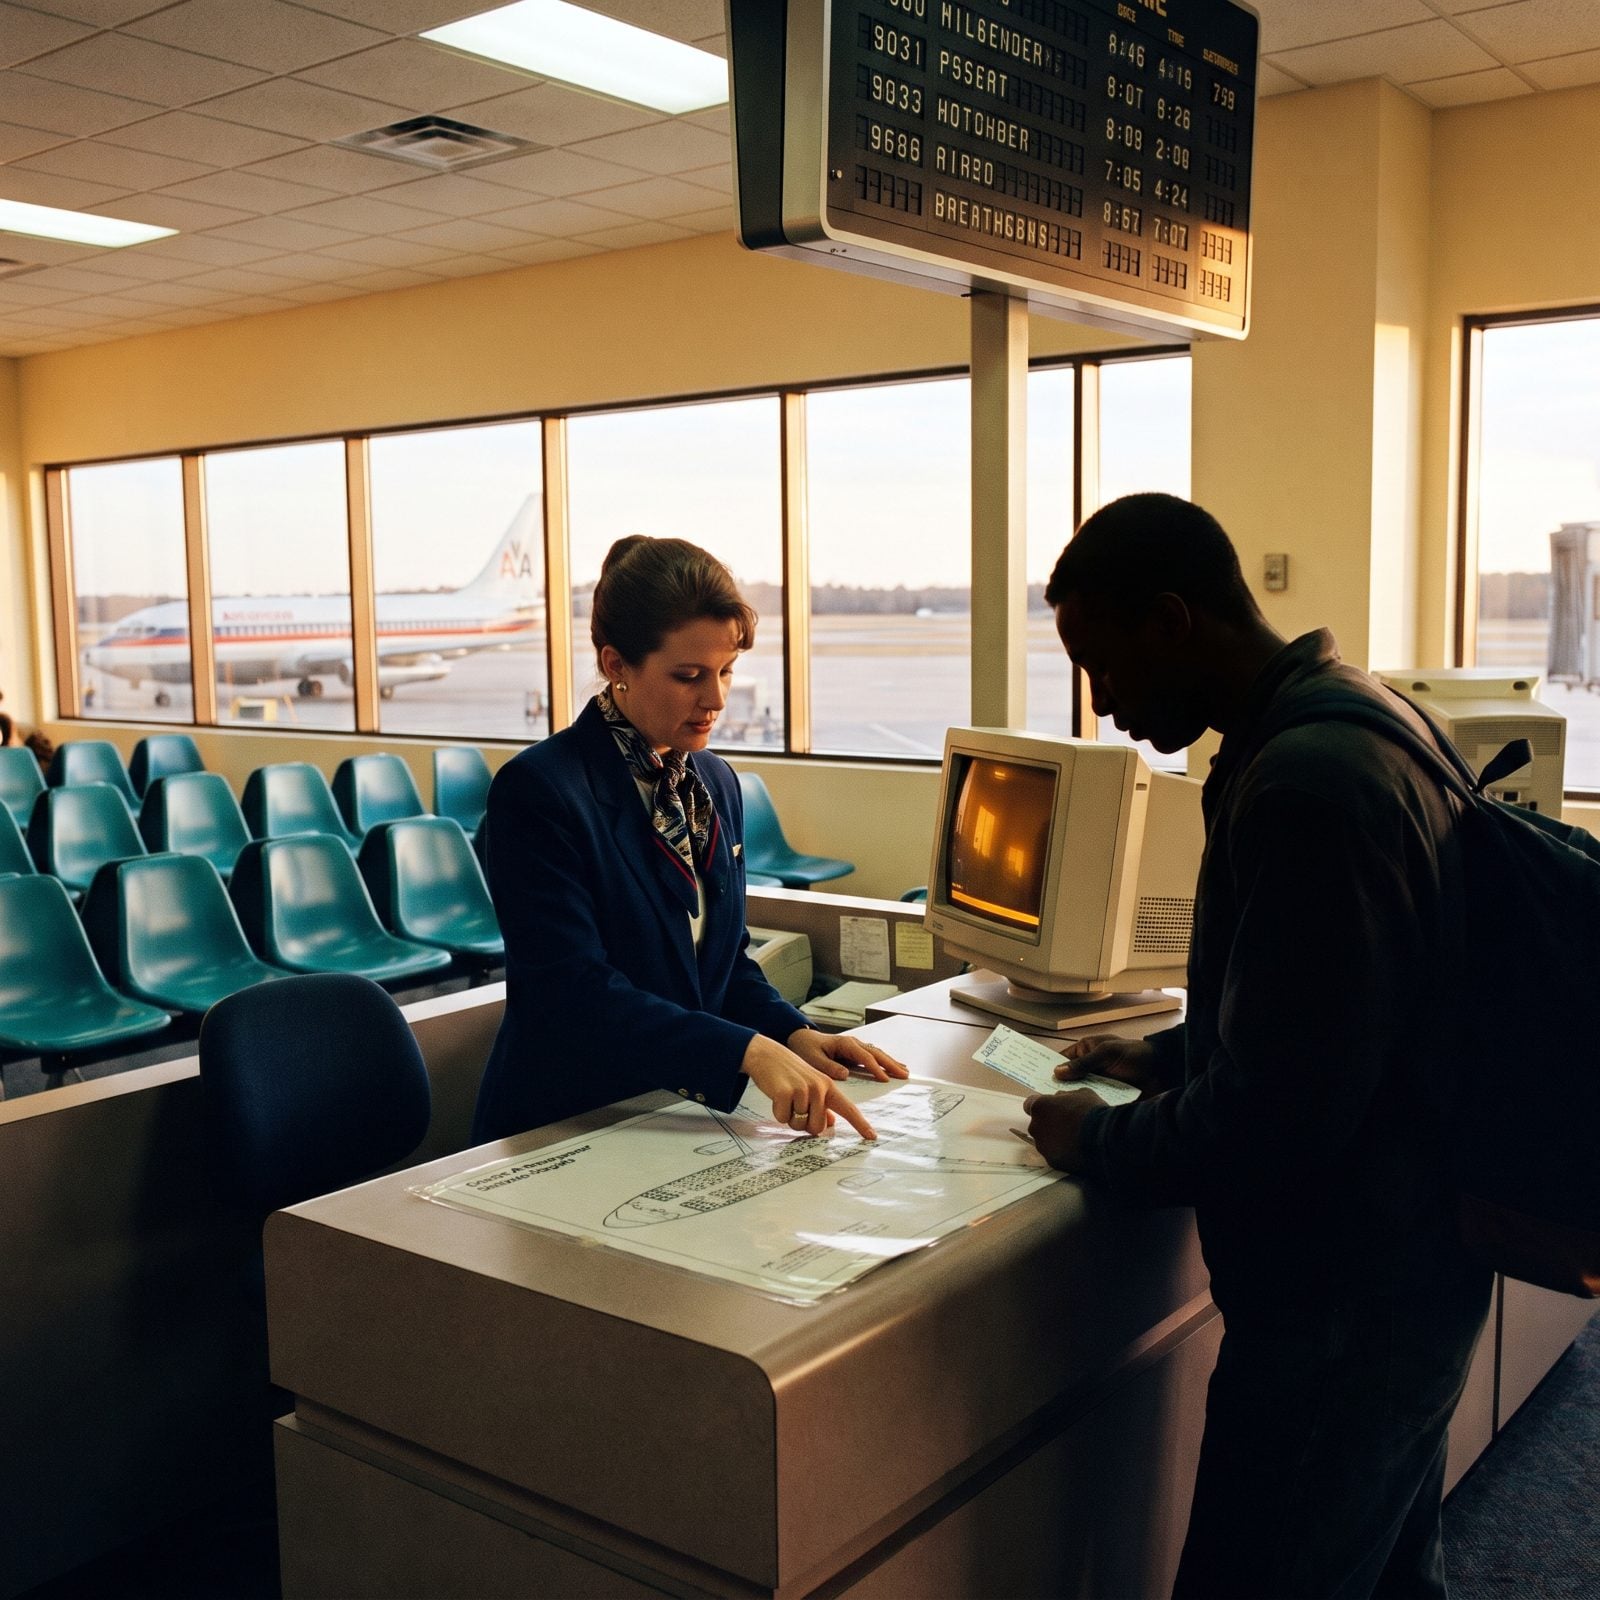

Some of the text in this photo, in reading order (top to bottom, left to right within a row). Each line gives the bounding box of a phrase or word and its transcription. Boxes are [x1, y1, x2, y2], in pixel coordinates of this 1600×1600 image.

[874, 25, 920, 66] 9031
[1105, 159, 1141, 191] 7:05
[1154, 179, 1188, 209] 4:24
[1154, 218, 1187, 250] 7:07
